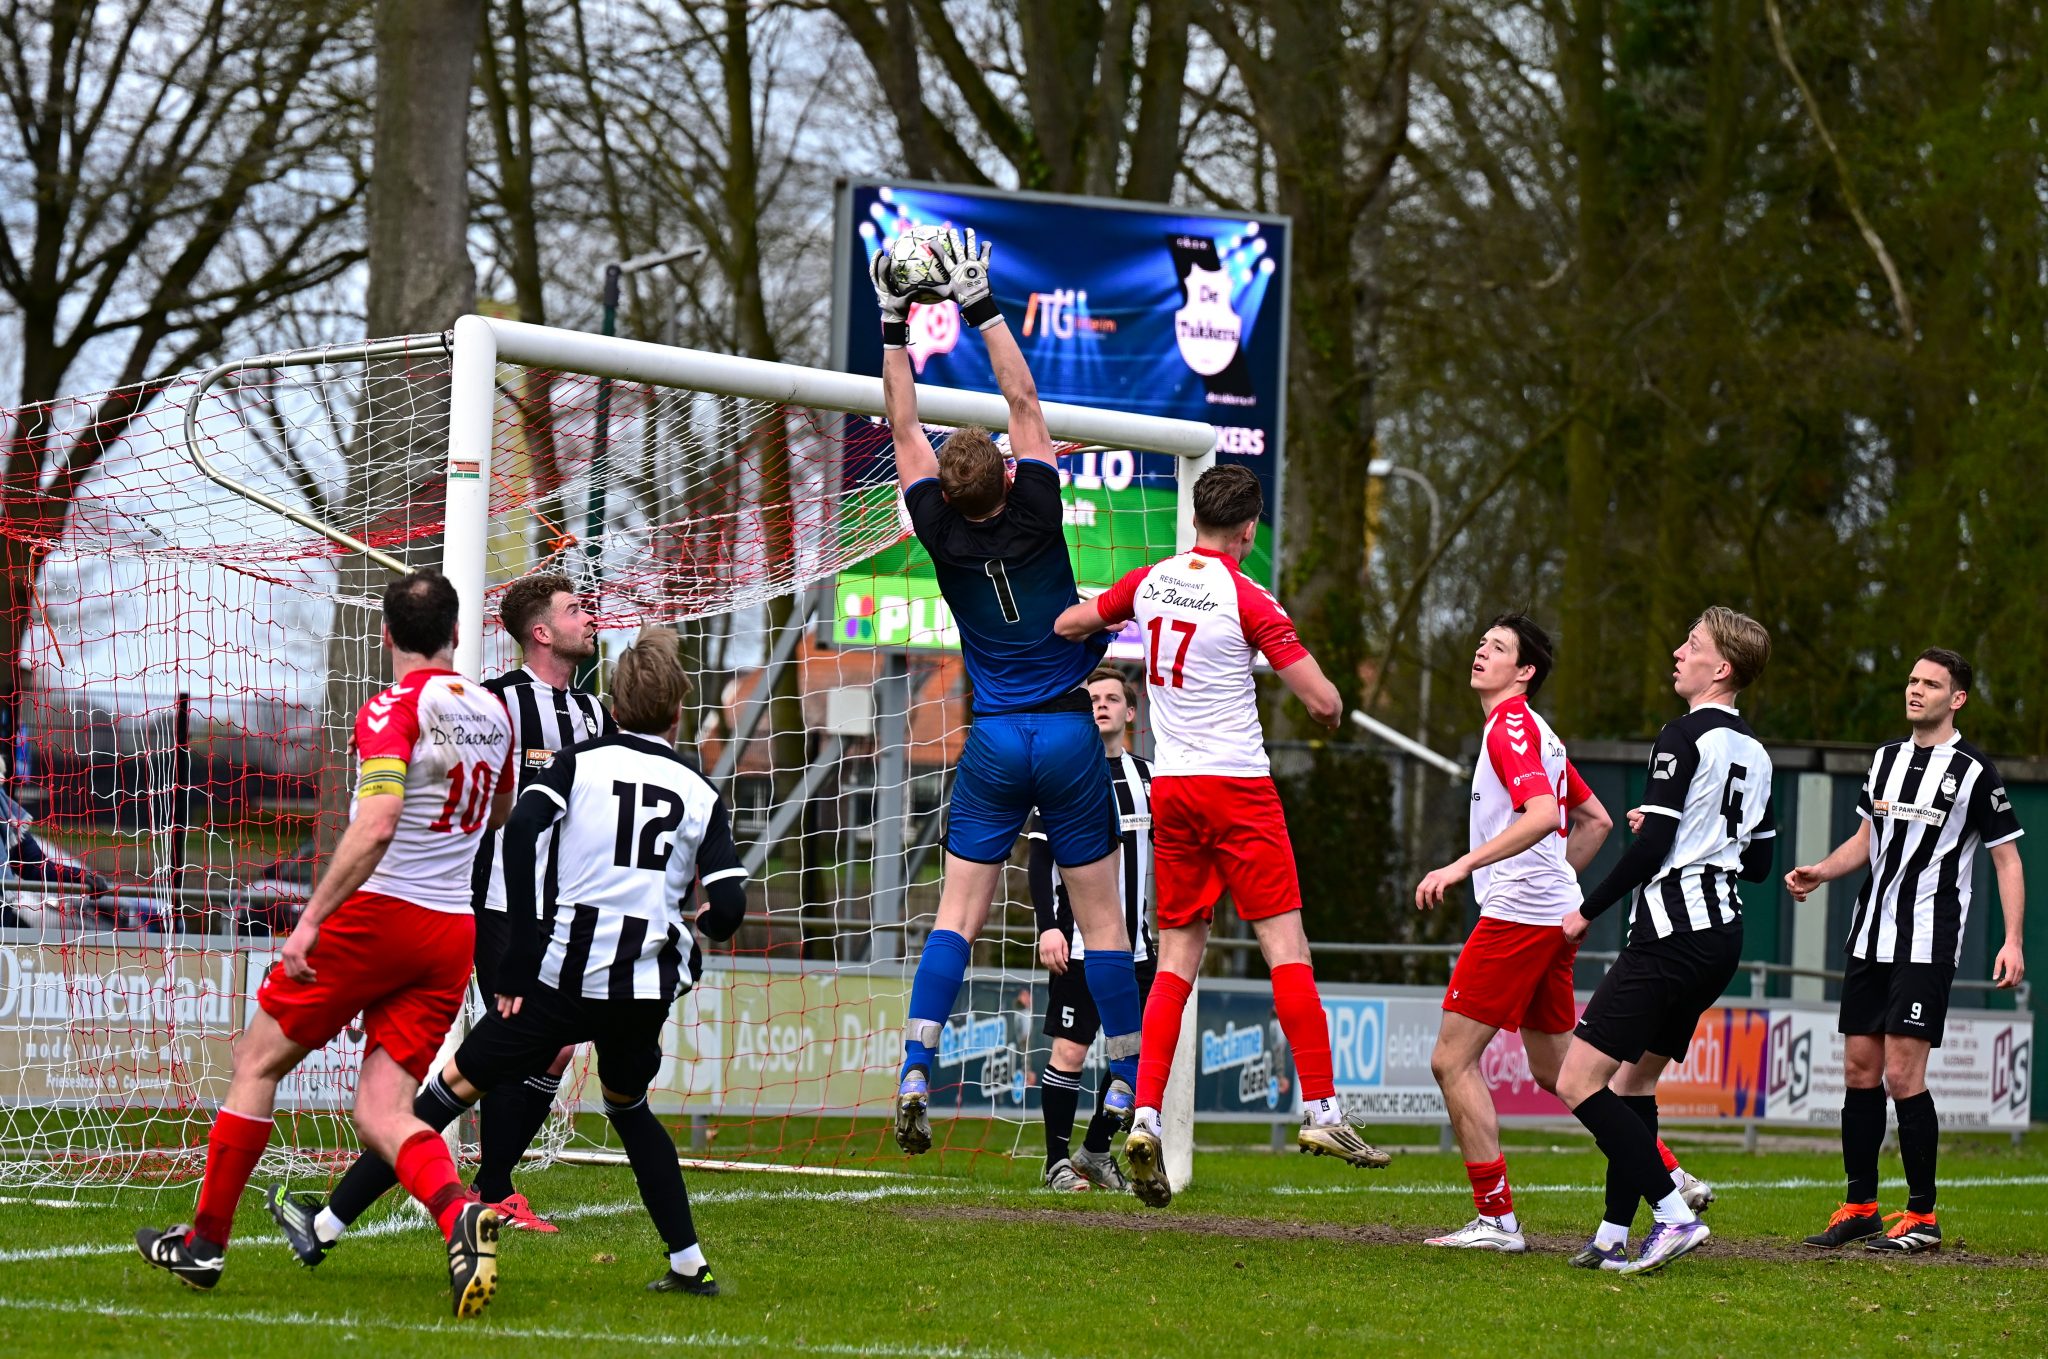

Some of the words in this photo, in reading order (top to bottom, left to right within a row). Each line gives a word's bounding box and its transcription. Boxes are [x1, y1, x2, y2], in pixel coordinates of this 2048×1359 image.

[984, 559, 1020, 624] 1
[1142, 583, 1161, 601] De
[1161, 588, 1219, 613] Baander
[1147, 616, 1198, 689] 17
[438, 714, 487, 723] RESTARANT
[429, 760, 494, 836] 10
[612, 779, 686, 872] 12
[1061, 1005, 1076, 1029] 5
[1910, 1002, 1923, 1020] 9
[25, 1035, 71, 1059] mode
[733, 1010, 815, 1073] Assen
[1202, 1021, 1263, 1075] Reclame
